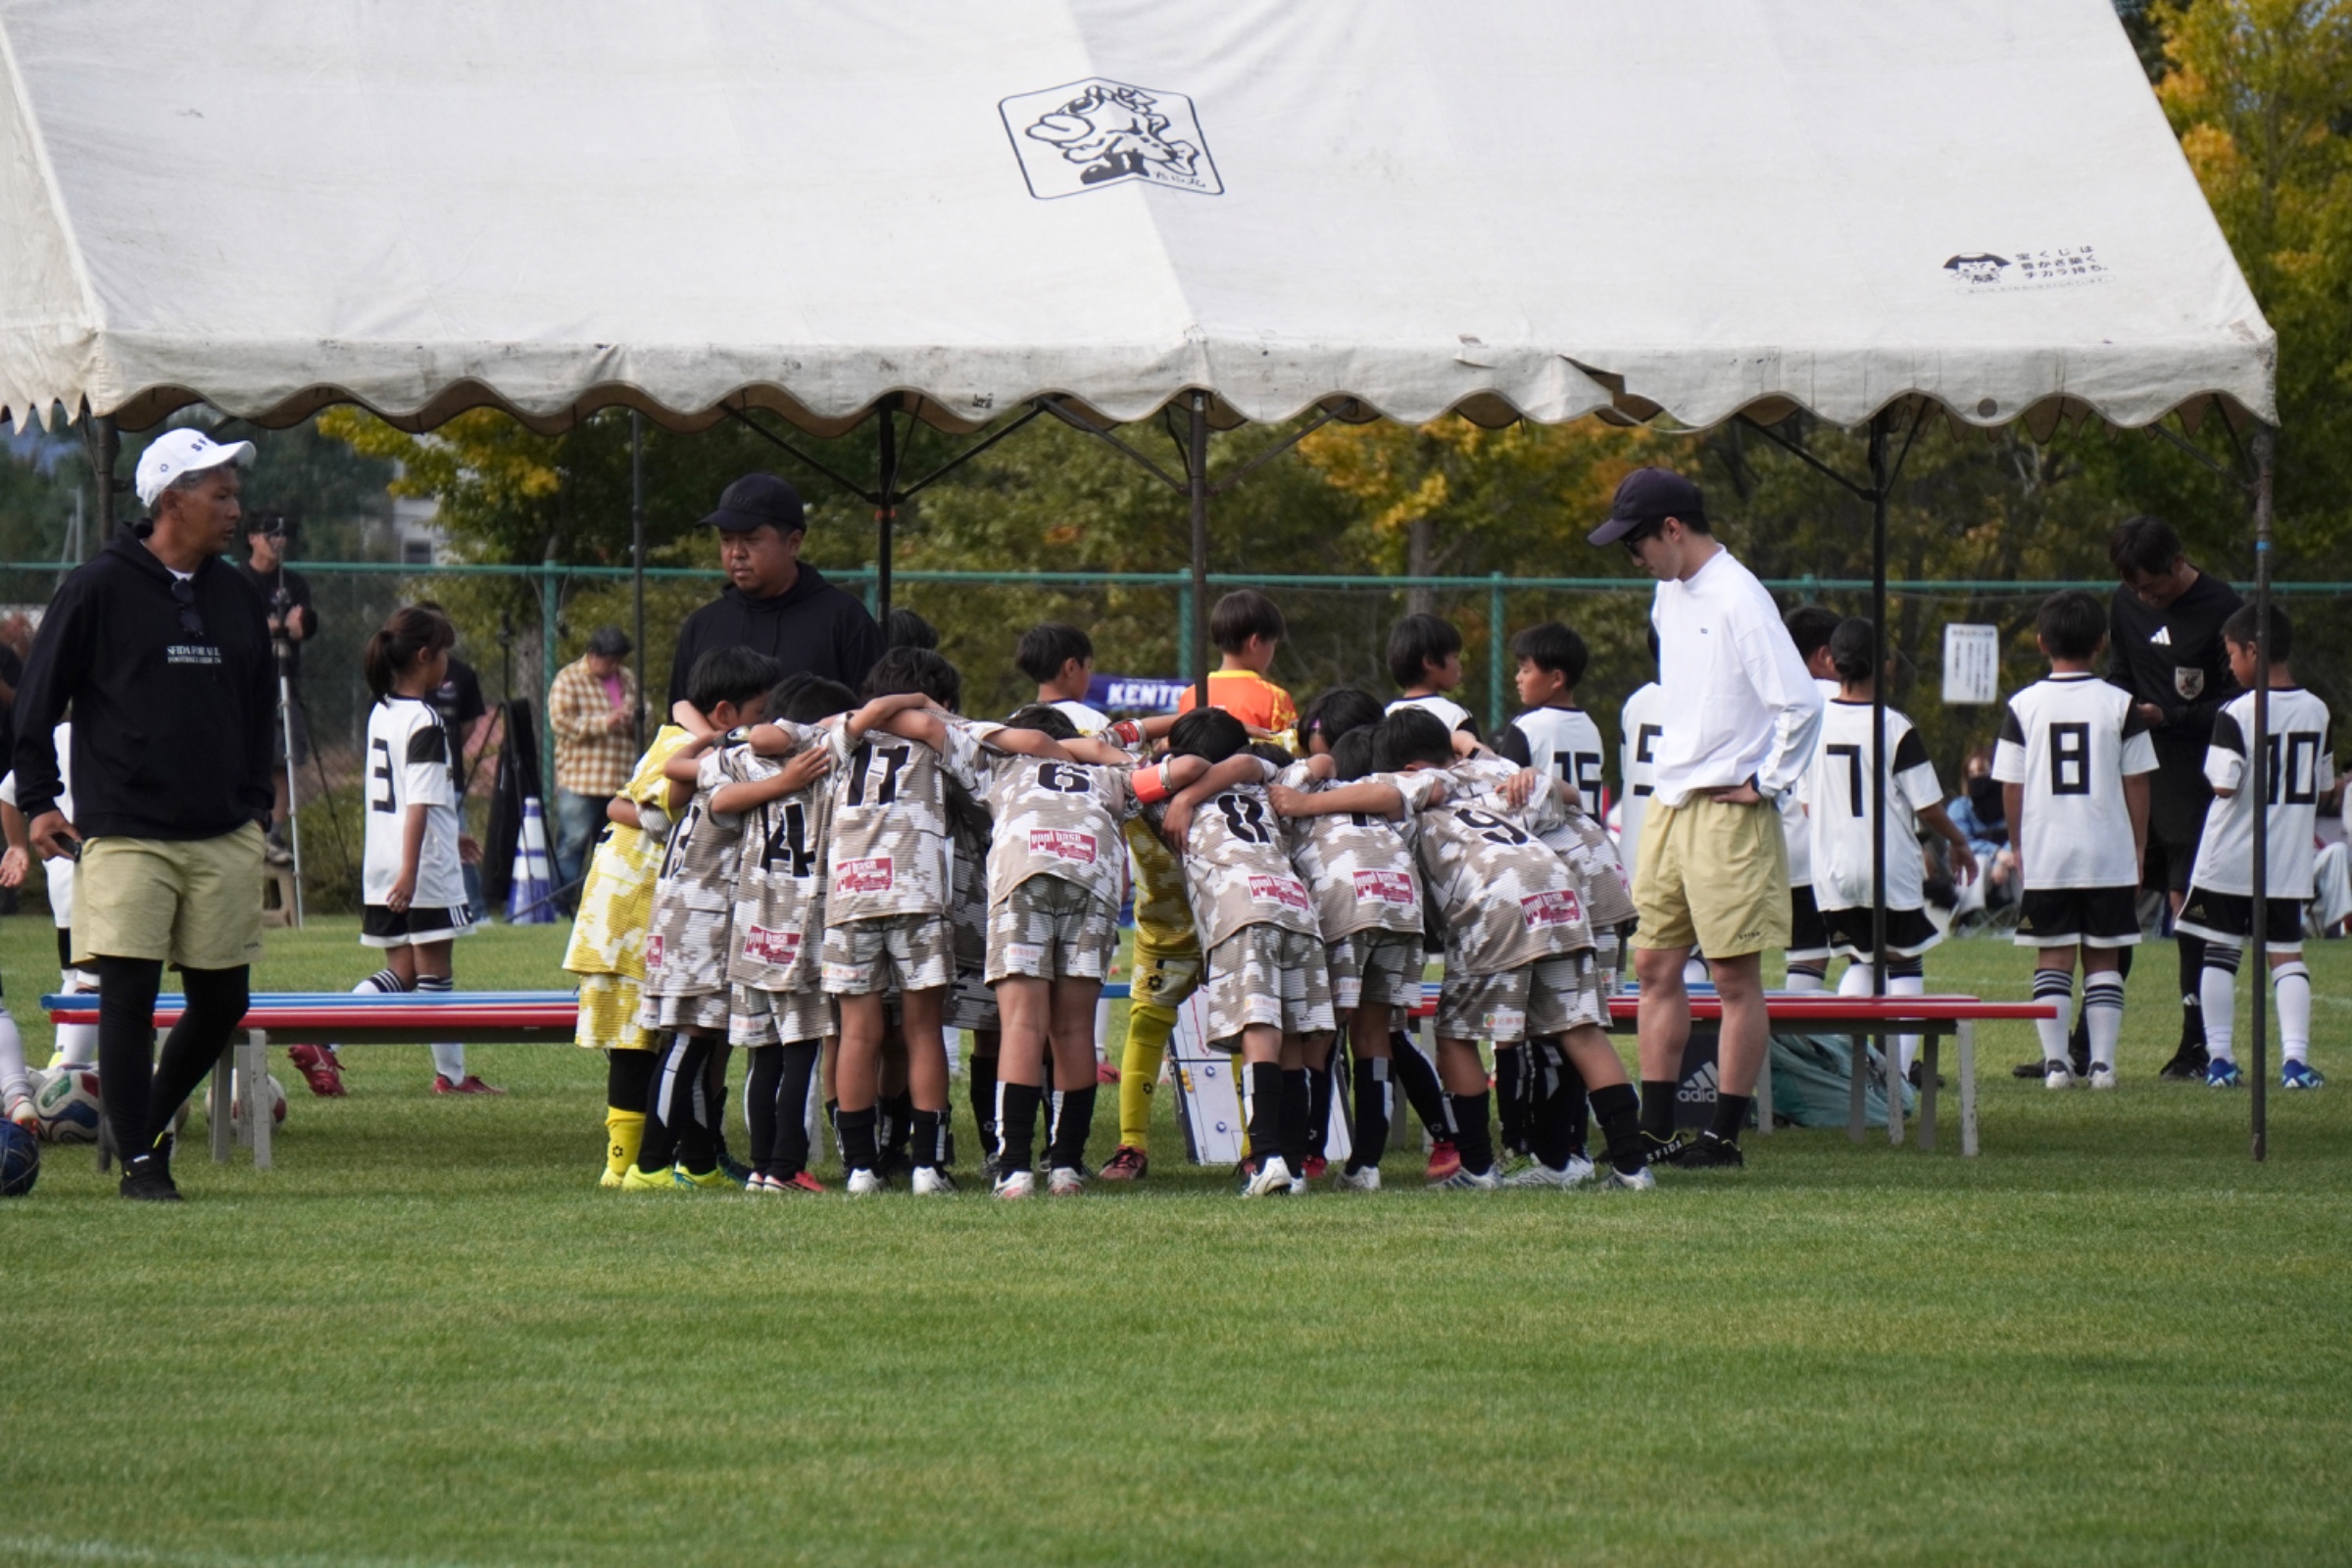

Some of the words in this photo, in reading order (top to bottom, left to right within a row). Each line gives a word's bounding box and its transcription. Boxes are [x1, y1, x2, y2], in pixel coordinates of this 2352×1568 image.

[372, 737, 396, 813] 3
[848, 741, 910, 807] 17
[1038, 762, 1090, 793] 6
[1827, 744, 1863, 817] 7
[2050, 722, 2090, 795] 8
[2257, 731, 2323, 805] 10
[1217, 794, 1271, 844] 8
[1453, 808, 1529, 846] 9
[1677, 1087, 1718, 1103] adid
[1646, 1139, 1684, 1163] SFIDA
